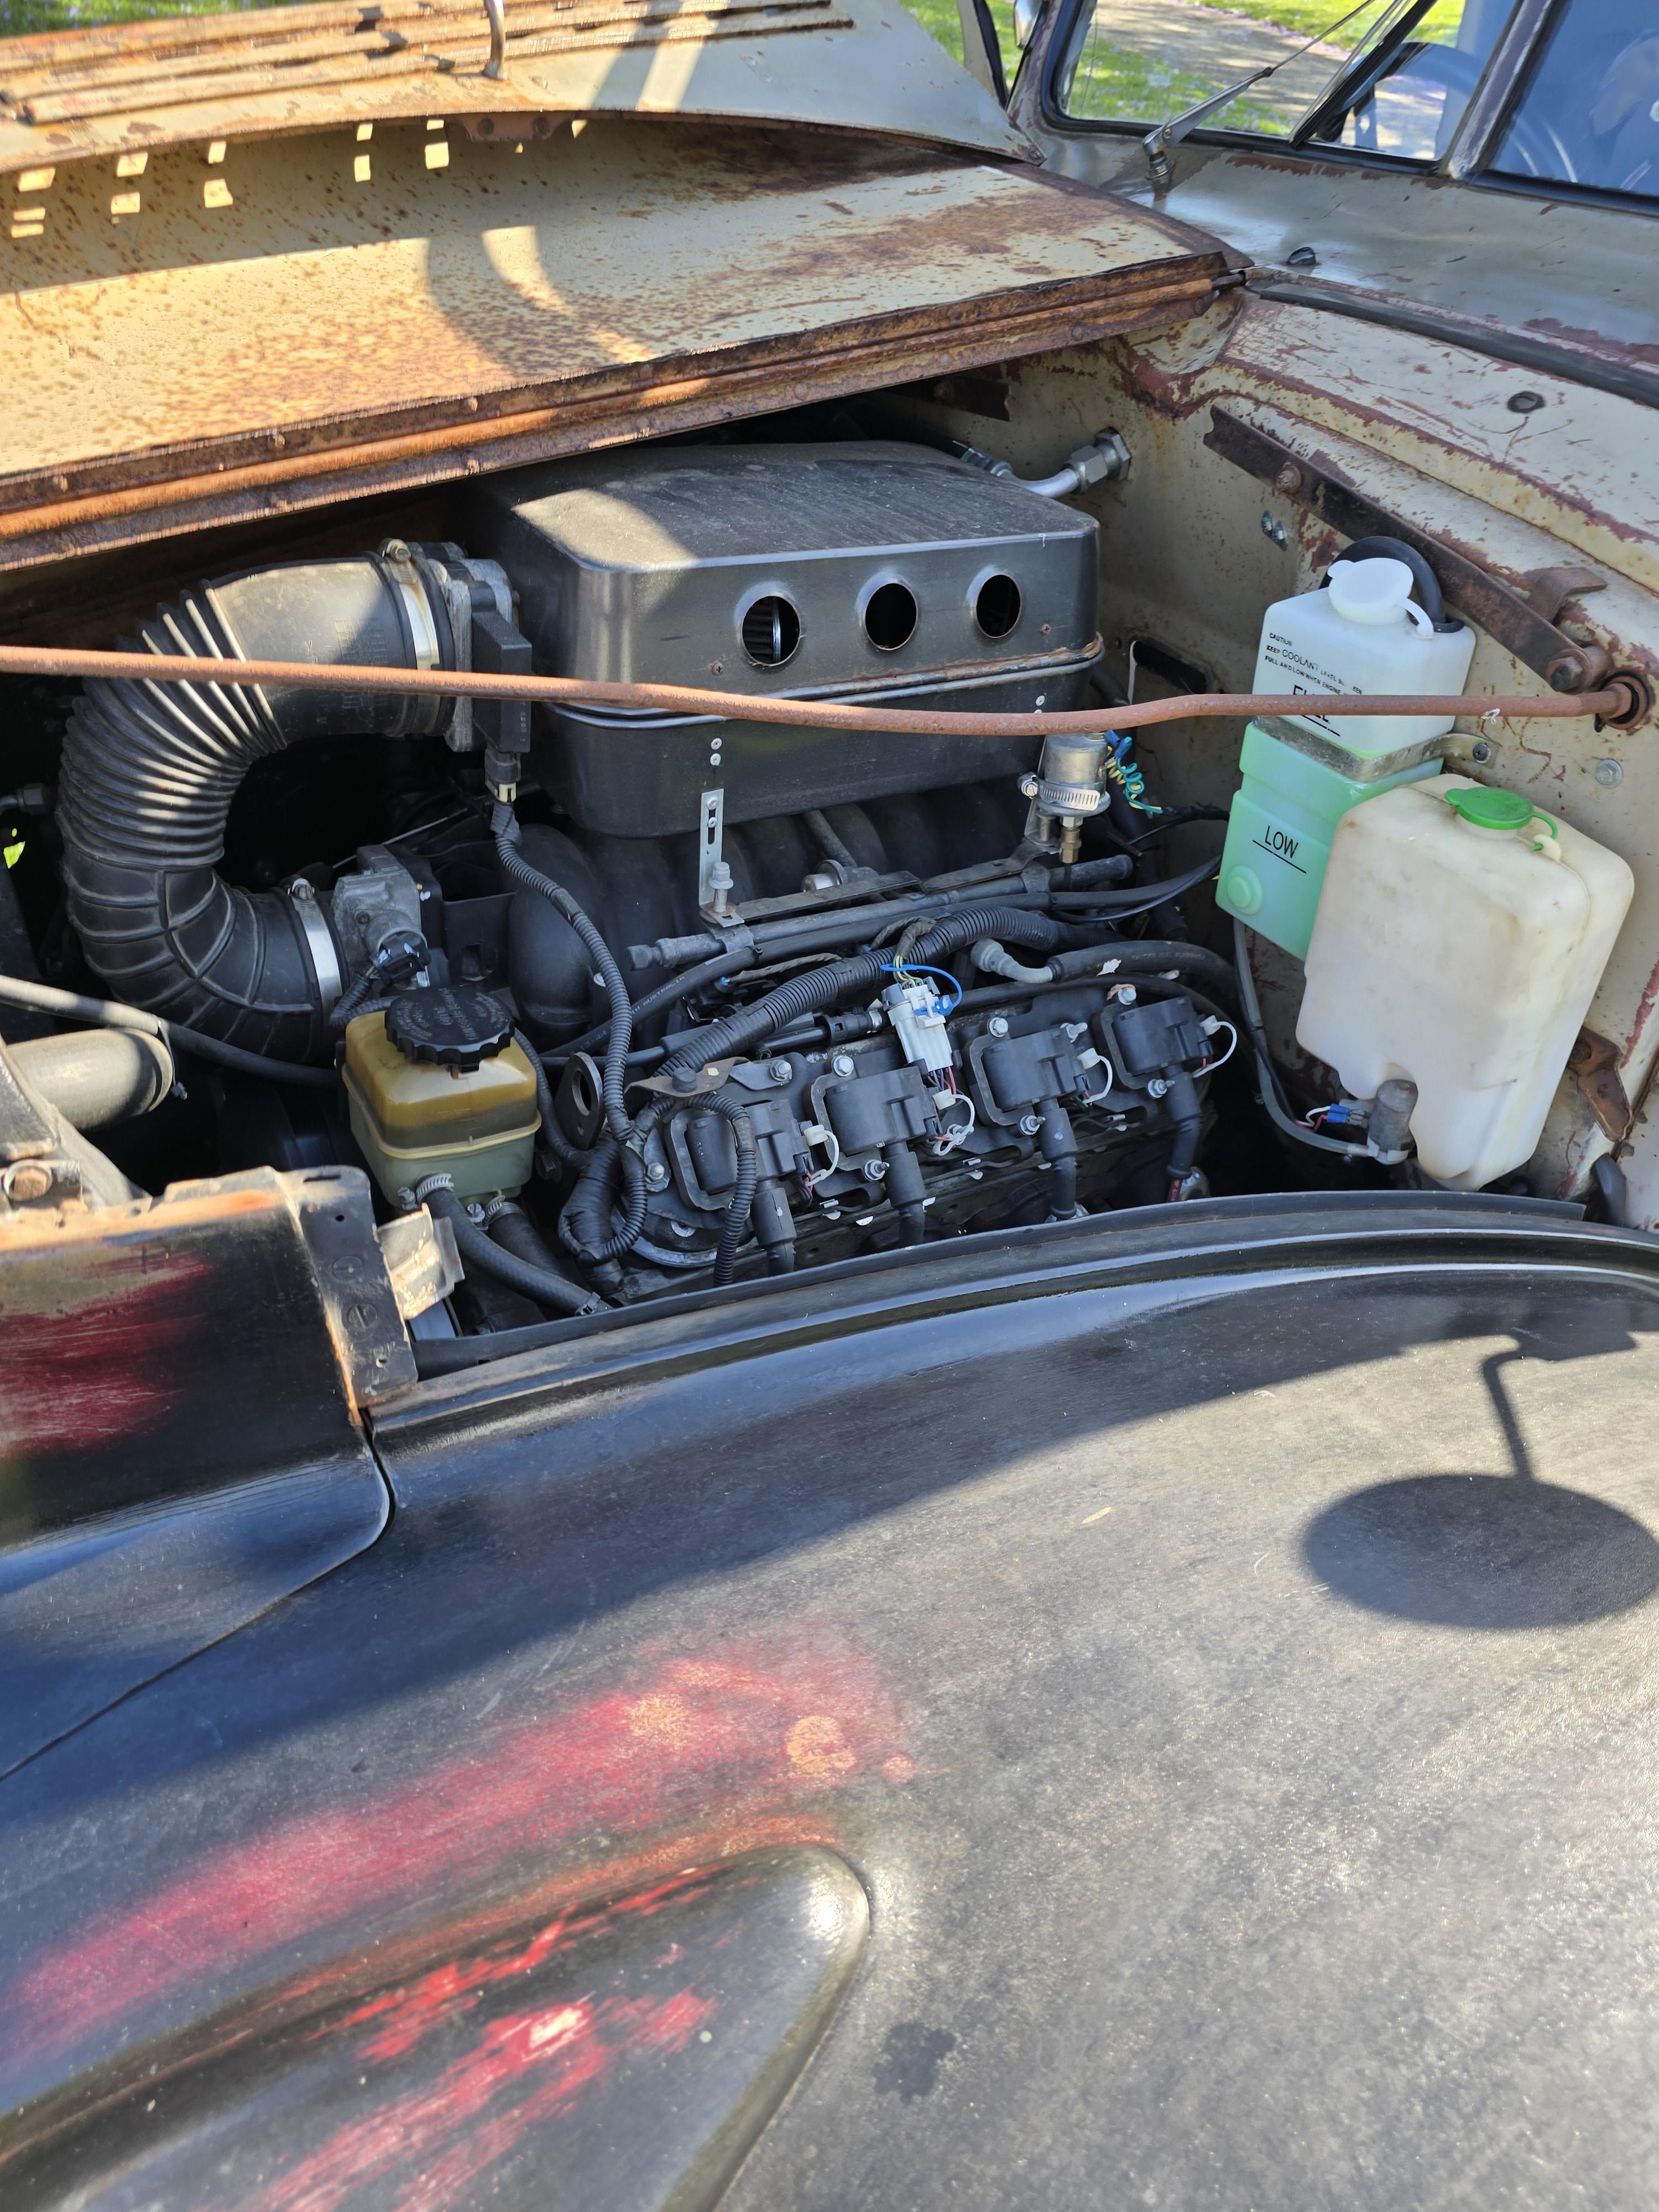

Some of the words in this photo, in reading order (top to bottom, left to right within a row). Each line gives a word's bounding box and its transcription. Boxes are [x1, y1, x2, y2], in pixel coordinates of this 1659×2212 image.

[1269, 633, 1292, 646] CAUTION
[1266, 645, 1280, 654] KEEP
[1282, 649, 1320, 672] COOLANT
[1265, 655, 1278, 665] FULL
[1280, 662, 1292, 671] AND
[1292, 667, 1305, 678] LOW
[1305, 673, 1321, 685] WHEN
[1322, 682, 1341, 695] ENGINE
[1265, 825, 1298, 859] LOW
